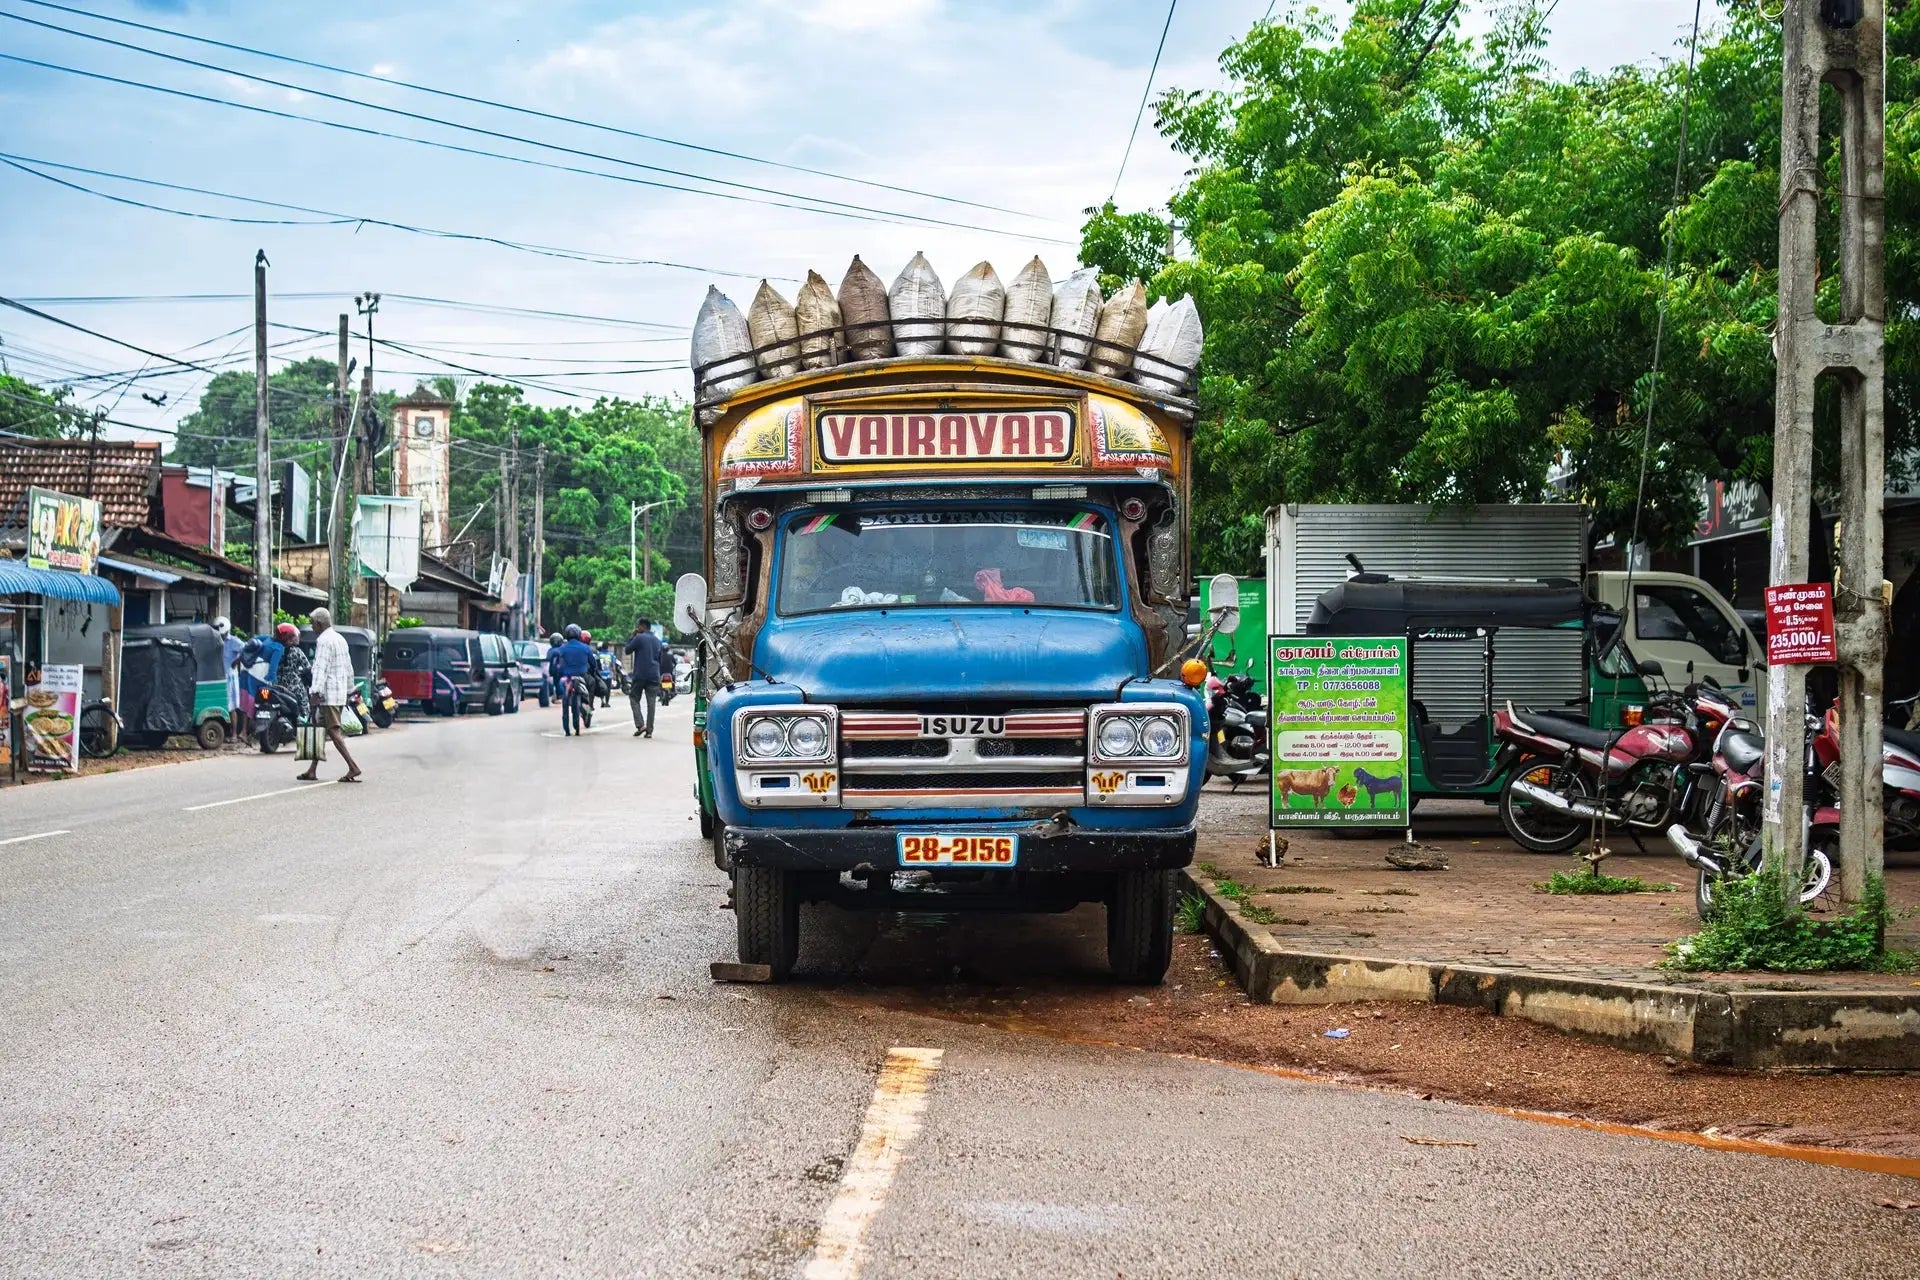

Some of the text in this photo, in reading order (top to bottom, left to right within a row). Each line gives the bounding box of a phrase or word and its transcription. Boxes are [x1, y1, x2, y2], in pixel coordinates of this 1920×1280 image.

[827, 414, 1064, 457] VAIRAVAR
[859, 511, 1067, 525] SATHU TRANSP
[1778, 586, 1826, 601] சண்முகம்
[1794, 602, 1824, 610] சேவை
[1770, 630, 1832, 648] 235,000/=
[1277, 642, 1336, 660] ஞானம்
[1278, 664, 1314, 678] கால்நடை
[1297, 681, 1309, 690] TP
[1323, 681, 1380, 690] 0773656088
[923, 717, 1004, 735] ISUZU
[904, 837, 1012, 862] 28-2156
